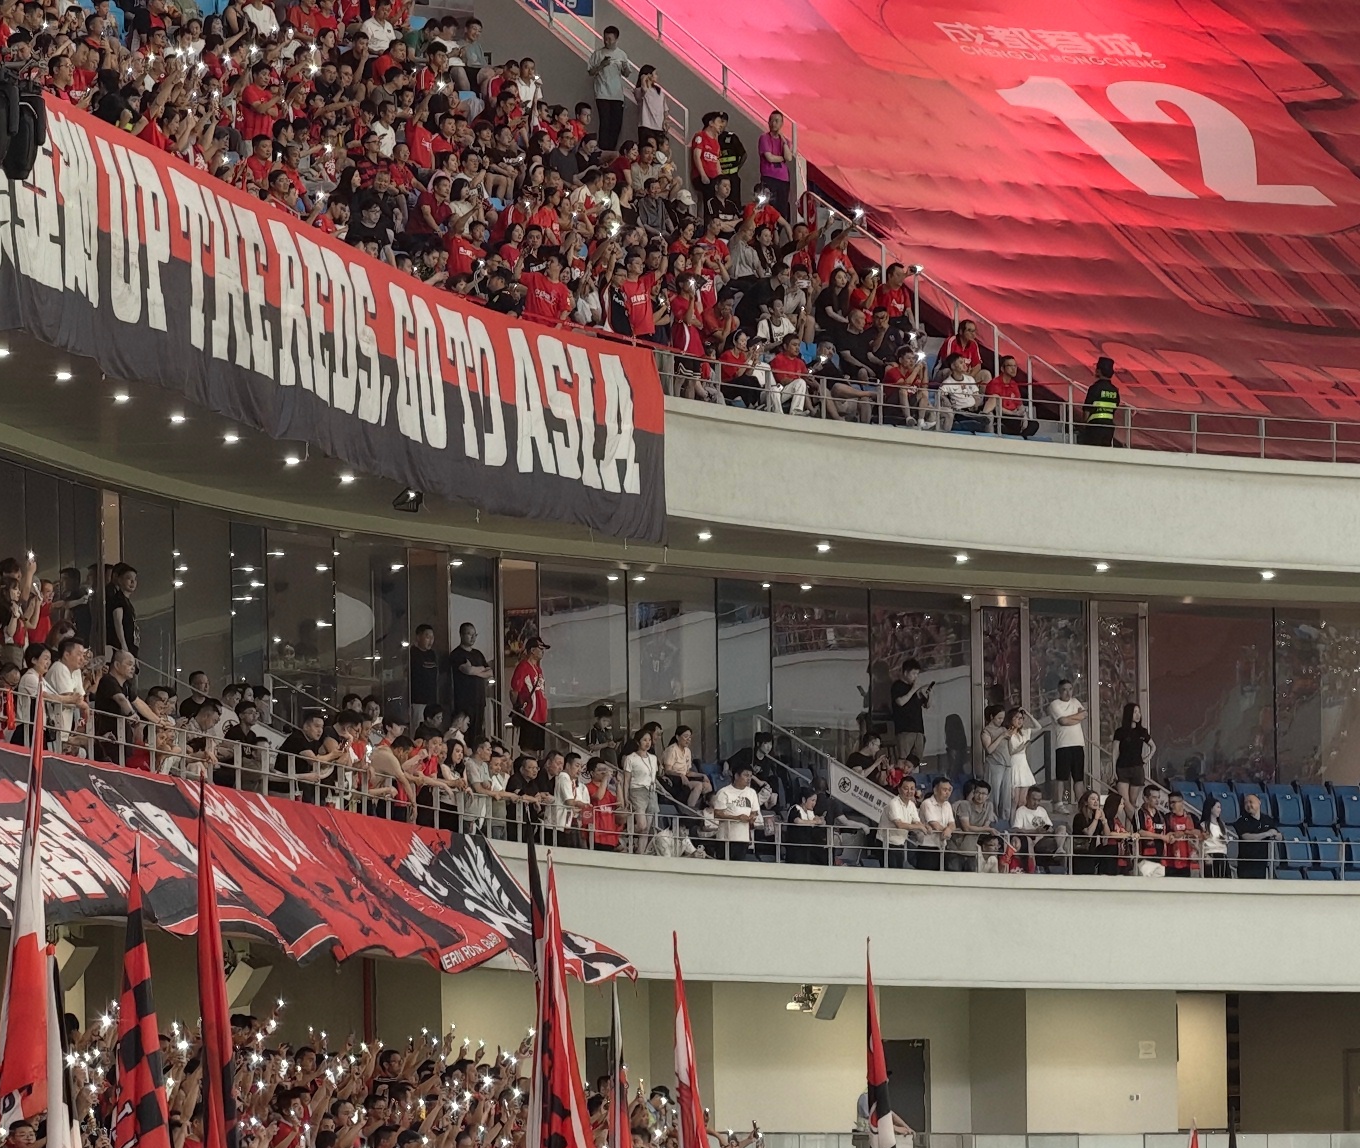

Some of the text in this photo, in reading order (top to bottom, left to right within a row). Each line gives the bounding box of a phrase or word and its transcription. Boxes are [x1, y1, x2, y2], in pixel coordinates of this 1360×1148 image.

[933, 21, 1152, 58] 成都蓉城
[959, 44, 1168, 70] CHENGDU RONGCHENG
[995, 75, 1338, 207] 12
[95, 135, 171, 332] UP
[167, 166, 275, 381] THE
[267, 219, 392, 428] REDS,
[388, 282, 448, 450] GO
[436, 303, 508, 467] TO
[507, 328, 641, 496] ASIA
